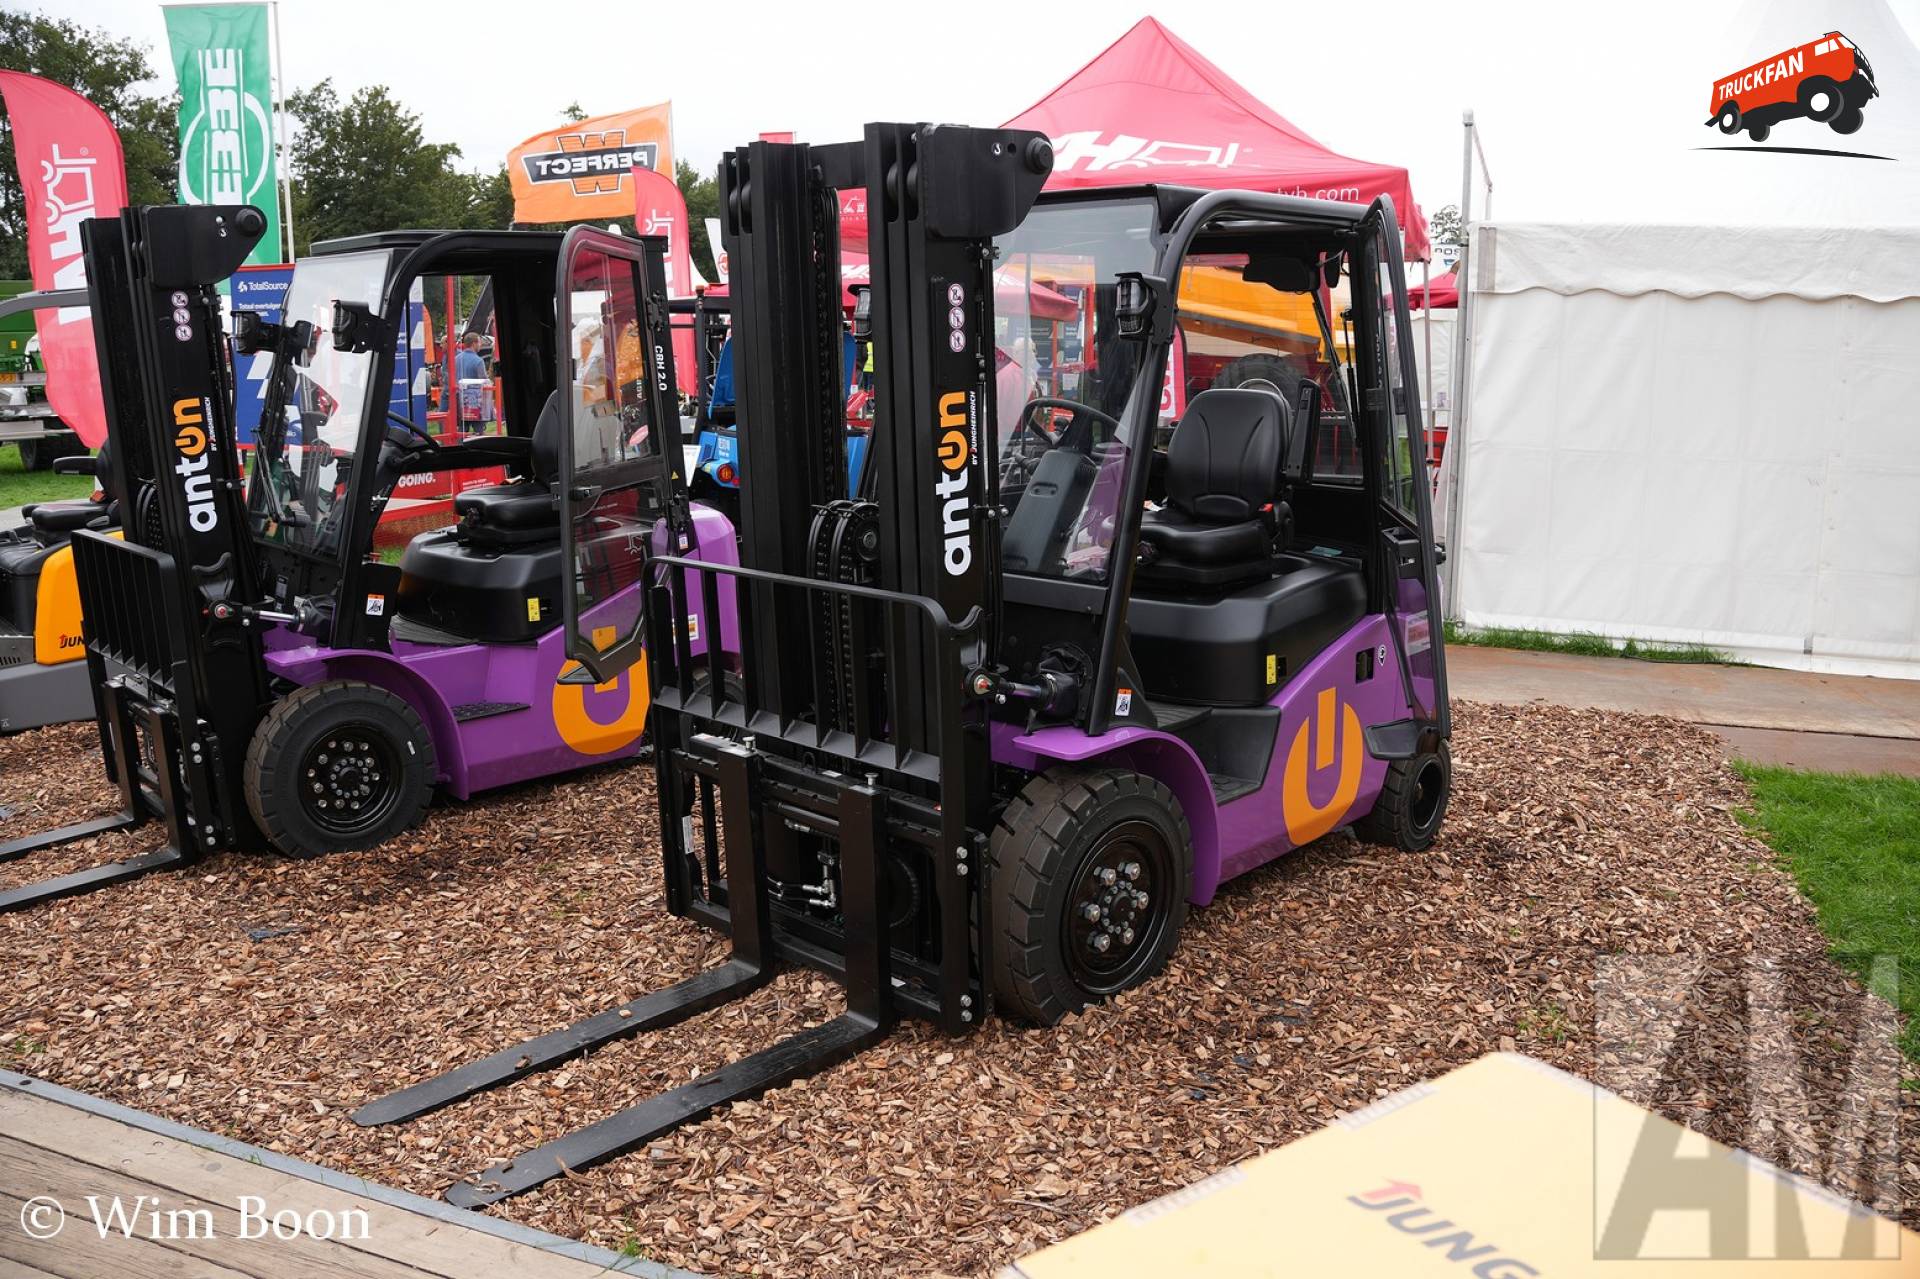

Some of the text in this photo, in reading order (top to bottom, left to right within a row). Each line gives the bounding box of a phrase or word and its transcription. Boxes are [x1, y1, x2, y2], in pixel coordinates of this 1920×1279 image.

[205, 49, 242, 205] EBBE
[658, 372, 668, 391] 2.0
[972, 455, 977, 466] BY
[398, 472, 436, 488] GOING.
